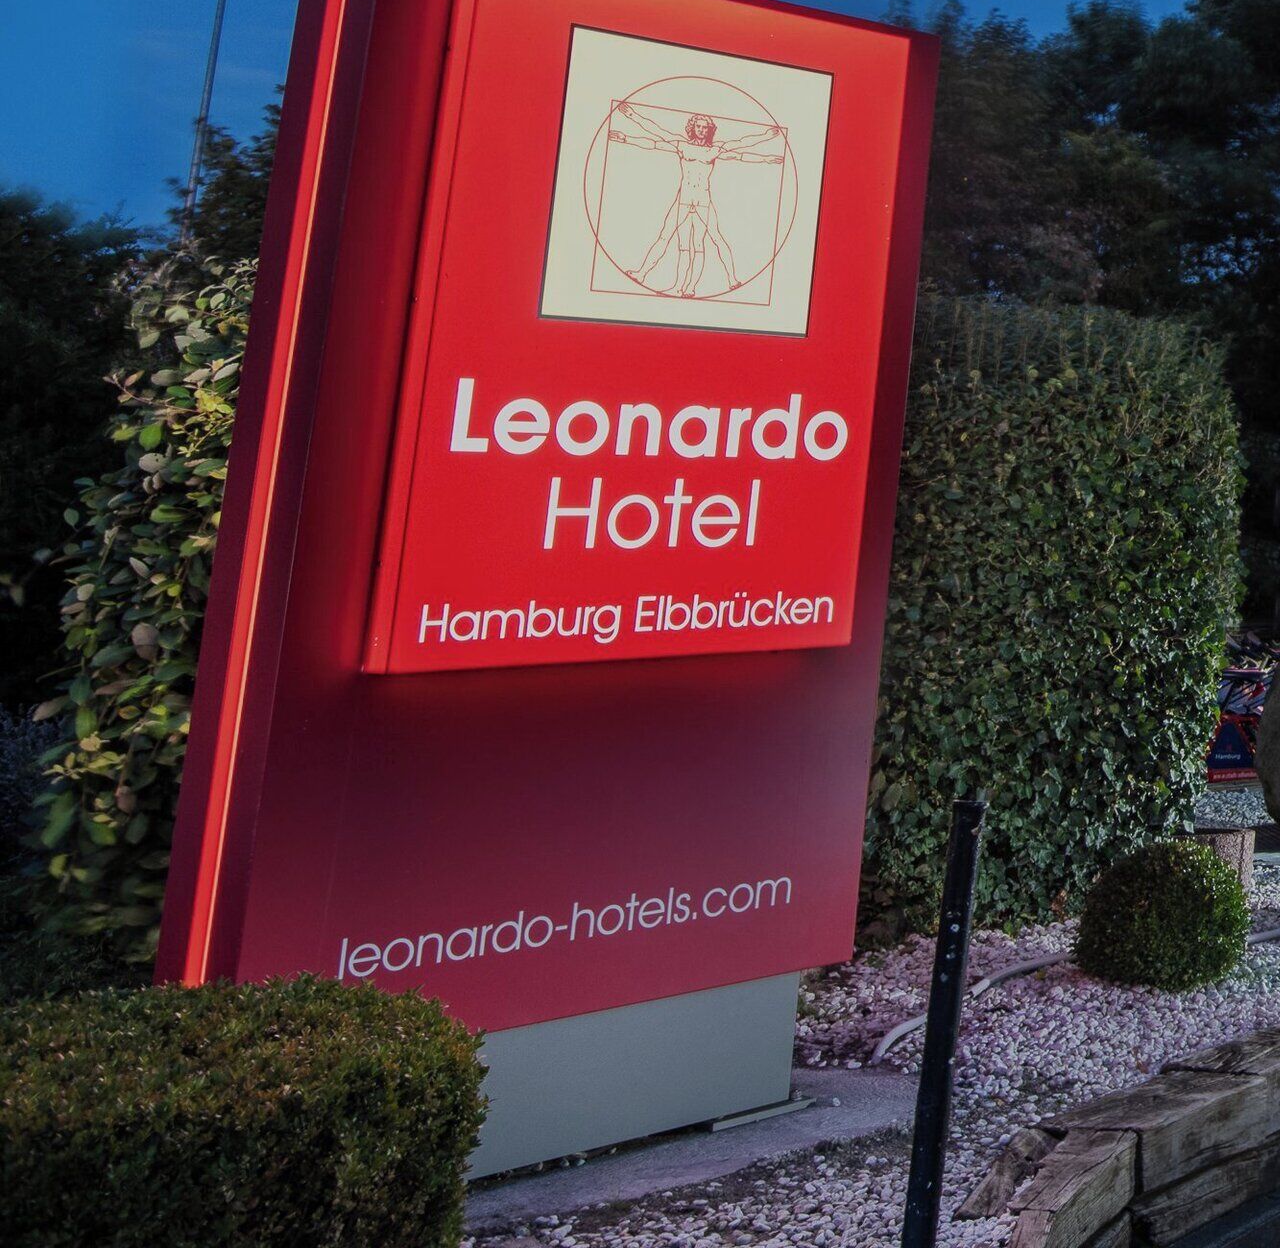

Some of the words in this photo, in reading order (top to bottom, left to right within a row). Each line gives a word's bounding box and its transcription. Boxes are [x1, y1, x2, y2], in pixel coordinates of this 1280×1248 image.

[450, 377, 849, 461] Leonardo
[543, 476, 760, 550] Hotel
[418, 600, 622, 645] Hamburg
[634, 590, 834, 633] Elbbrücken
[338, 876, 793, 980] leonardo-hotels.com
